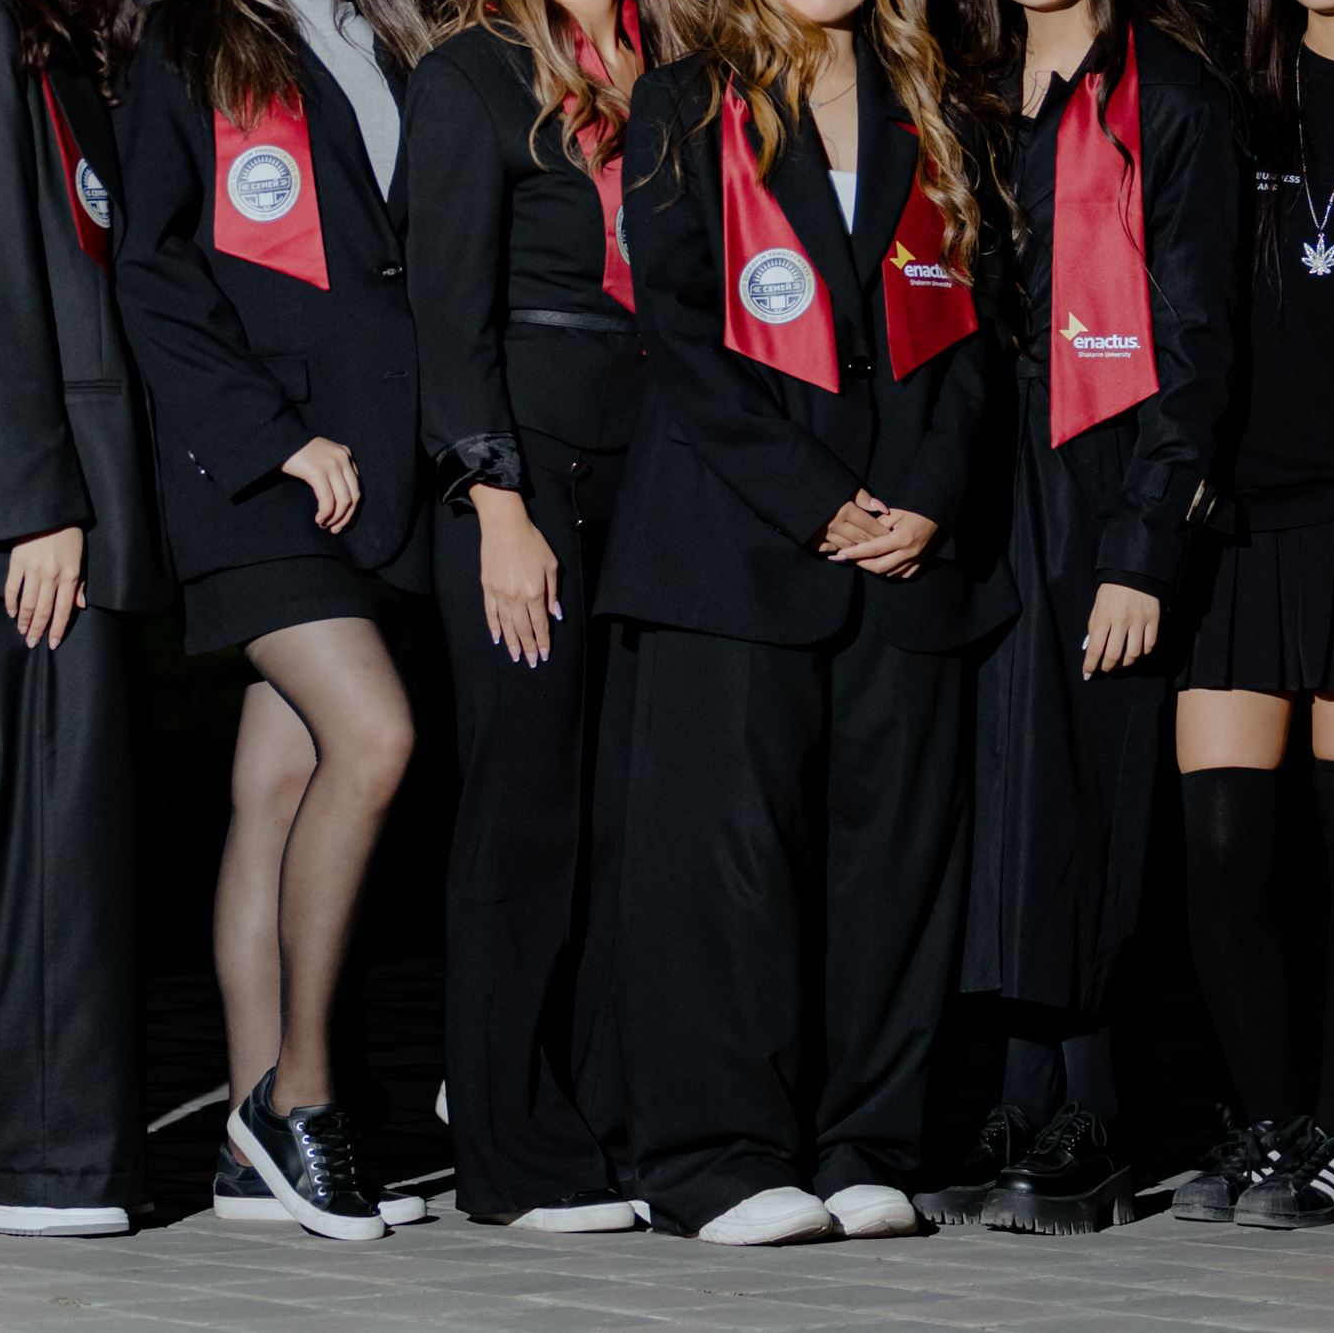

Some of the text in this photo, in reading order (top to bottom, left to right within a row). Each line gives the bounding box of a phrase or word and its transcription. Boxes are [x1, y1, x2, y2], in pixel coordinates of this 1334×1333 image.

[1256, 171, 1301, 184] BUESS
[251, 179, 279, 190] СЕМЕЙ
[763, 282, 792, 293] СЕМЕЙ
[1073, 334, 1141, 349] enactus.
